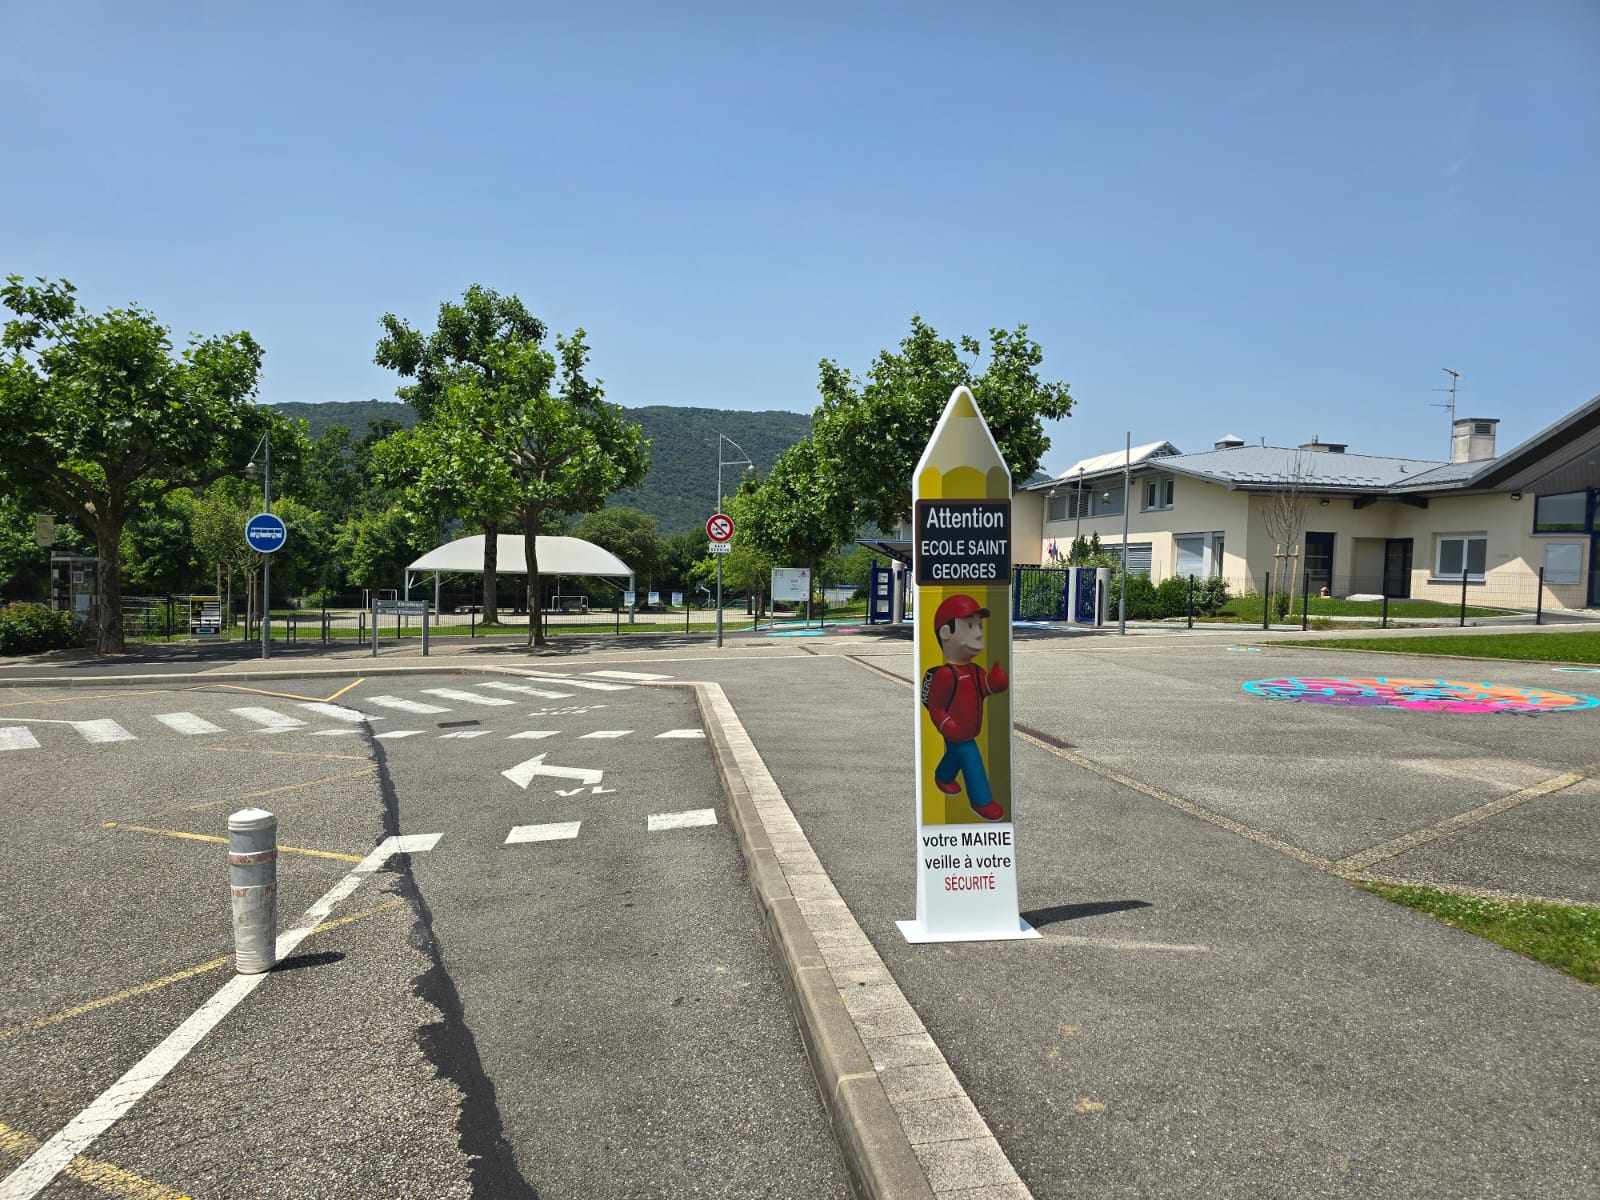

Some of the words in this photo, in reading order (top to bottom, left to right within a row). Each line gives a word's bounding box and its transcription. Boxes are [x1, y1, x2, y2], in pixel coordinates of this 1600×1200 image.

[926, 507, 1004, 528] Attention
[921, 540, 965, 555] ECOLE
[968, 540, 1008, 555] SAINT
[932, 563, 997, 579] GEORGES
[922, 833, 958, 847] votre
[961, 832, 1012, 846] MAIRIE
[925, 854, 961, 869] veille
[964, 854, 973, 868] à
[976, 853, 1011, 868] votre
[944, 872, 996, 891] SÉCURITÉ
